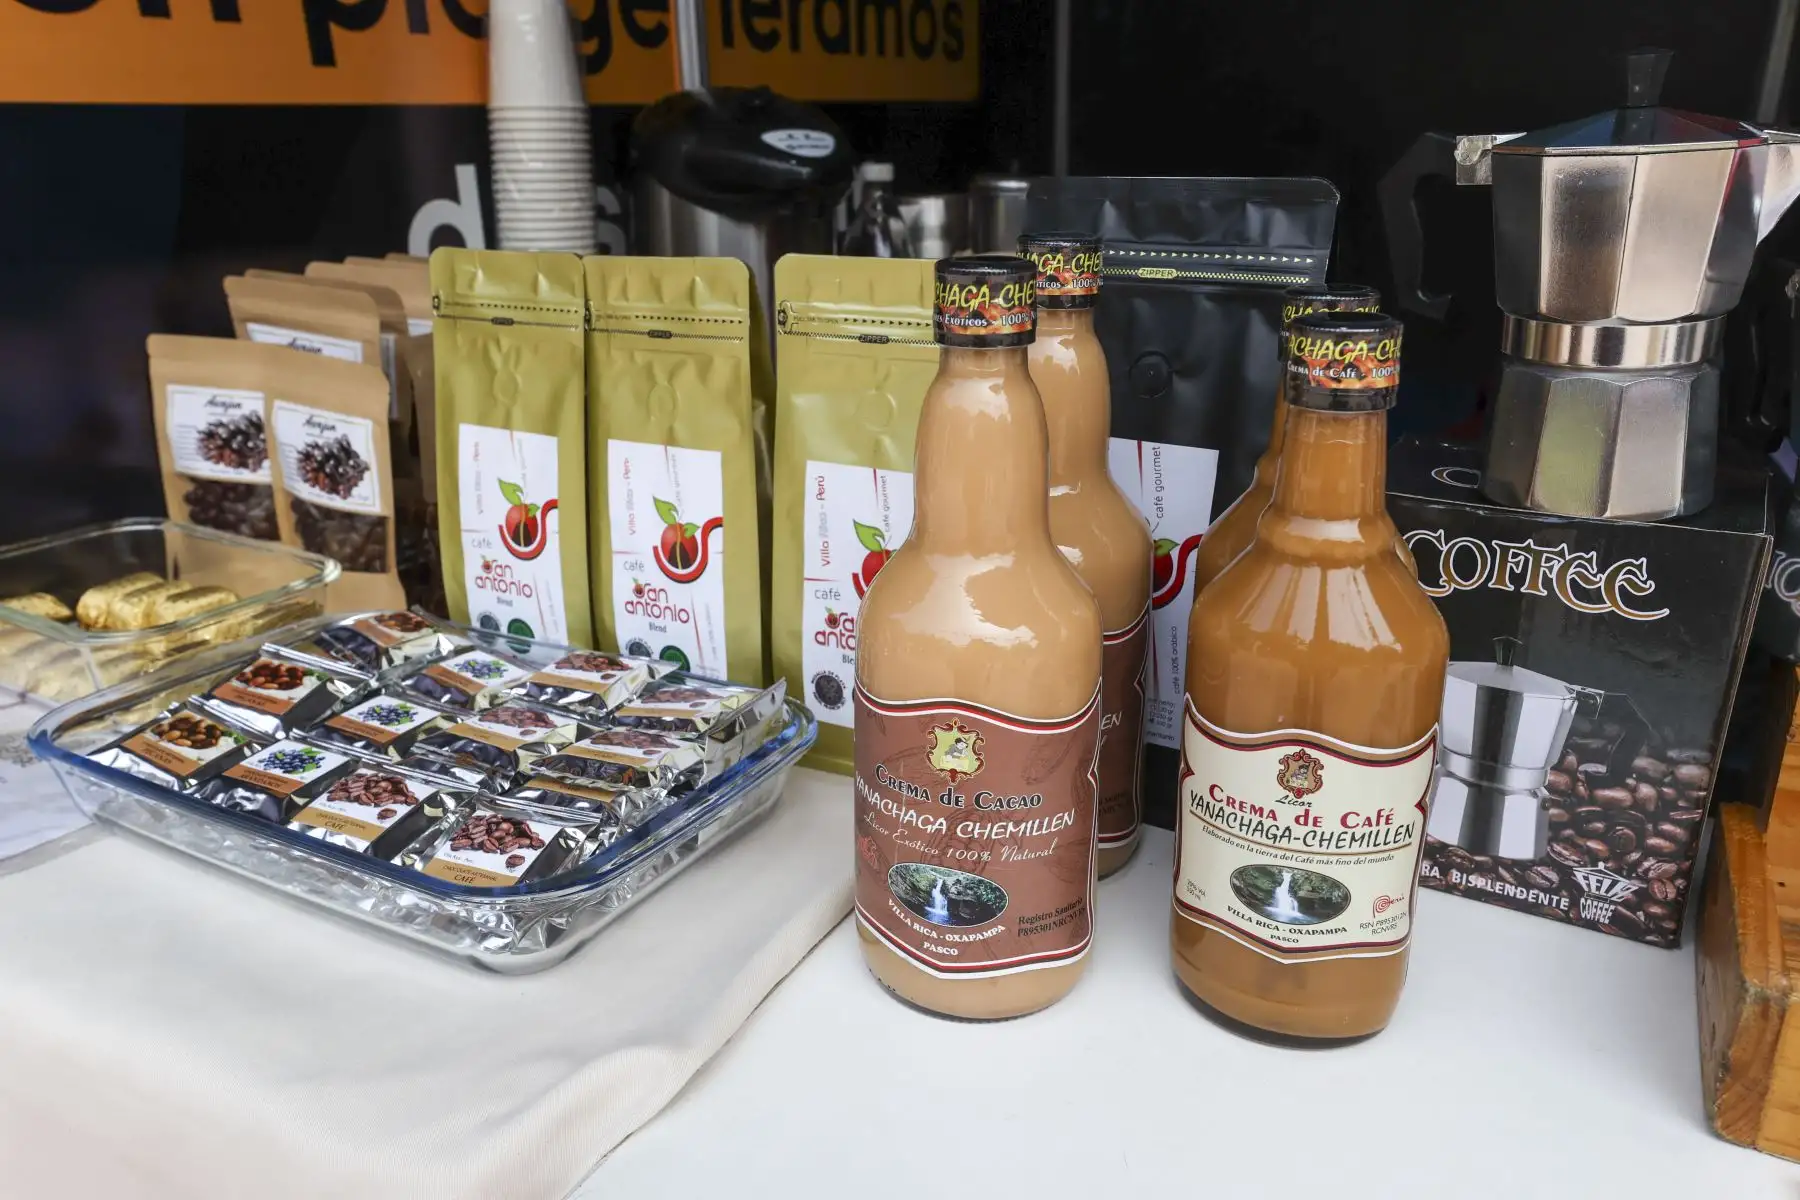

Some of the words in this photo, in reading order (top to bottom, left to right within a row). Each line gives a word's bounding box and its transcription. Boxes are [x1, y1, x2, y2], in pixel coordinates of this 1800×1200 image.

[1141, 268, 1176, 278] ZIPPER
[858, 334, 888, 344] ZIPPER
[1153, 445, 1164, 494] gourmet
[815, 475, 826, 501] Perú
[1153, 494, 1163, 519] café
[623, 559, 645, 572] café
[1402, 528, 1671, 622] COFFEE
[475, 575, 533, 598] antonio
[814, 589, 842, 602] café
[624, 600, 690, 624] antonio
[648, 621, 668, 634] Blend
[1274, 794, 1313, 809] Licor
[956, 808, 1076, 841] CHEMILLEN
[1189, 788, 1416, 850] YANACHAGA-CHEMILLEN
[892, 828, 940, 857] Exótico
[945, 843, 992, 863] 100%
[1000, 837, 1059, 863] Natural
[1201, 825, 1235, 847] Elaborado
[1235, 841, 1246, 851] en
[1246, 844, 1254, 854] la
[1255, 847, 1279, 861] tierra
[1280, 851, 1294, 862] del
[1294, 855, 1315, 865] Café
[1315, 857, 1333, 866] más
[1335, 857, 1353, 867] fino
[1353, 855, 1367, 865] del
[1367, 853, 1395, 865] mundo
[1451, 869, 1570, 912] BISPLENDENTE
[887, 898, 913, 929] VILLA
[913, 922, 939, 941] RICA
[945, 923, 1007, 943] OXAPAMPA
[1018, 911, 1054, 926] Registro
[1226, 905, 1253, 923] VILLA
[1255, 919, 1280, 933] RICA
[1288, 926, 1348, 937] OXAPAMPA
[1579, 896, 1616, 925] COFFEE
[922, 941, 959, 957] PASCO
[1270, 934, 1300, 944] PASCO
